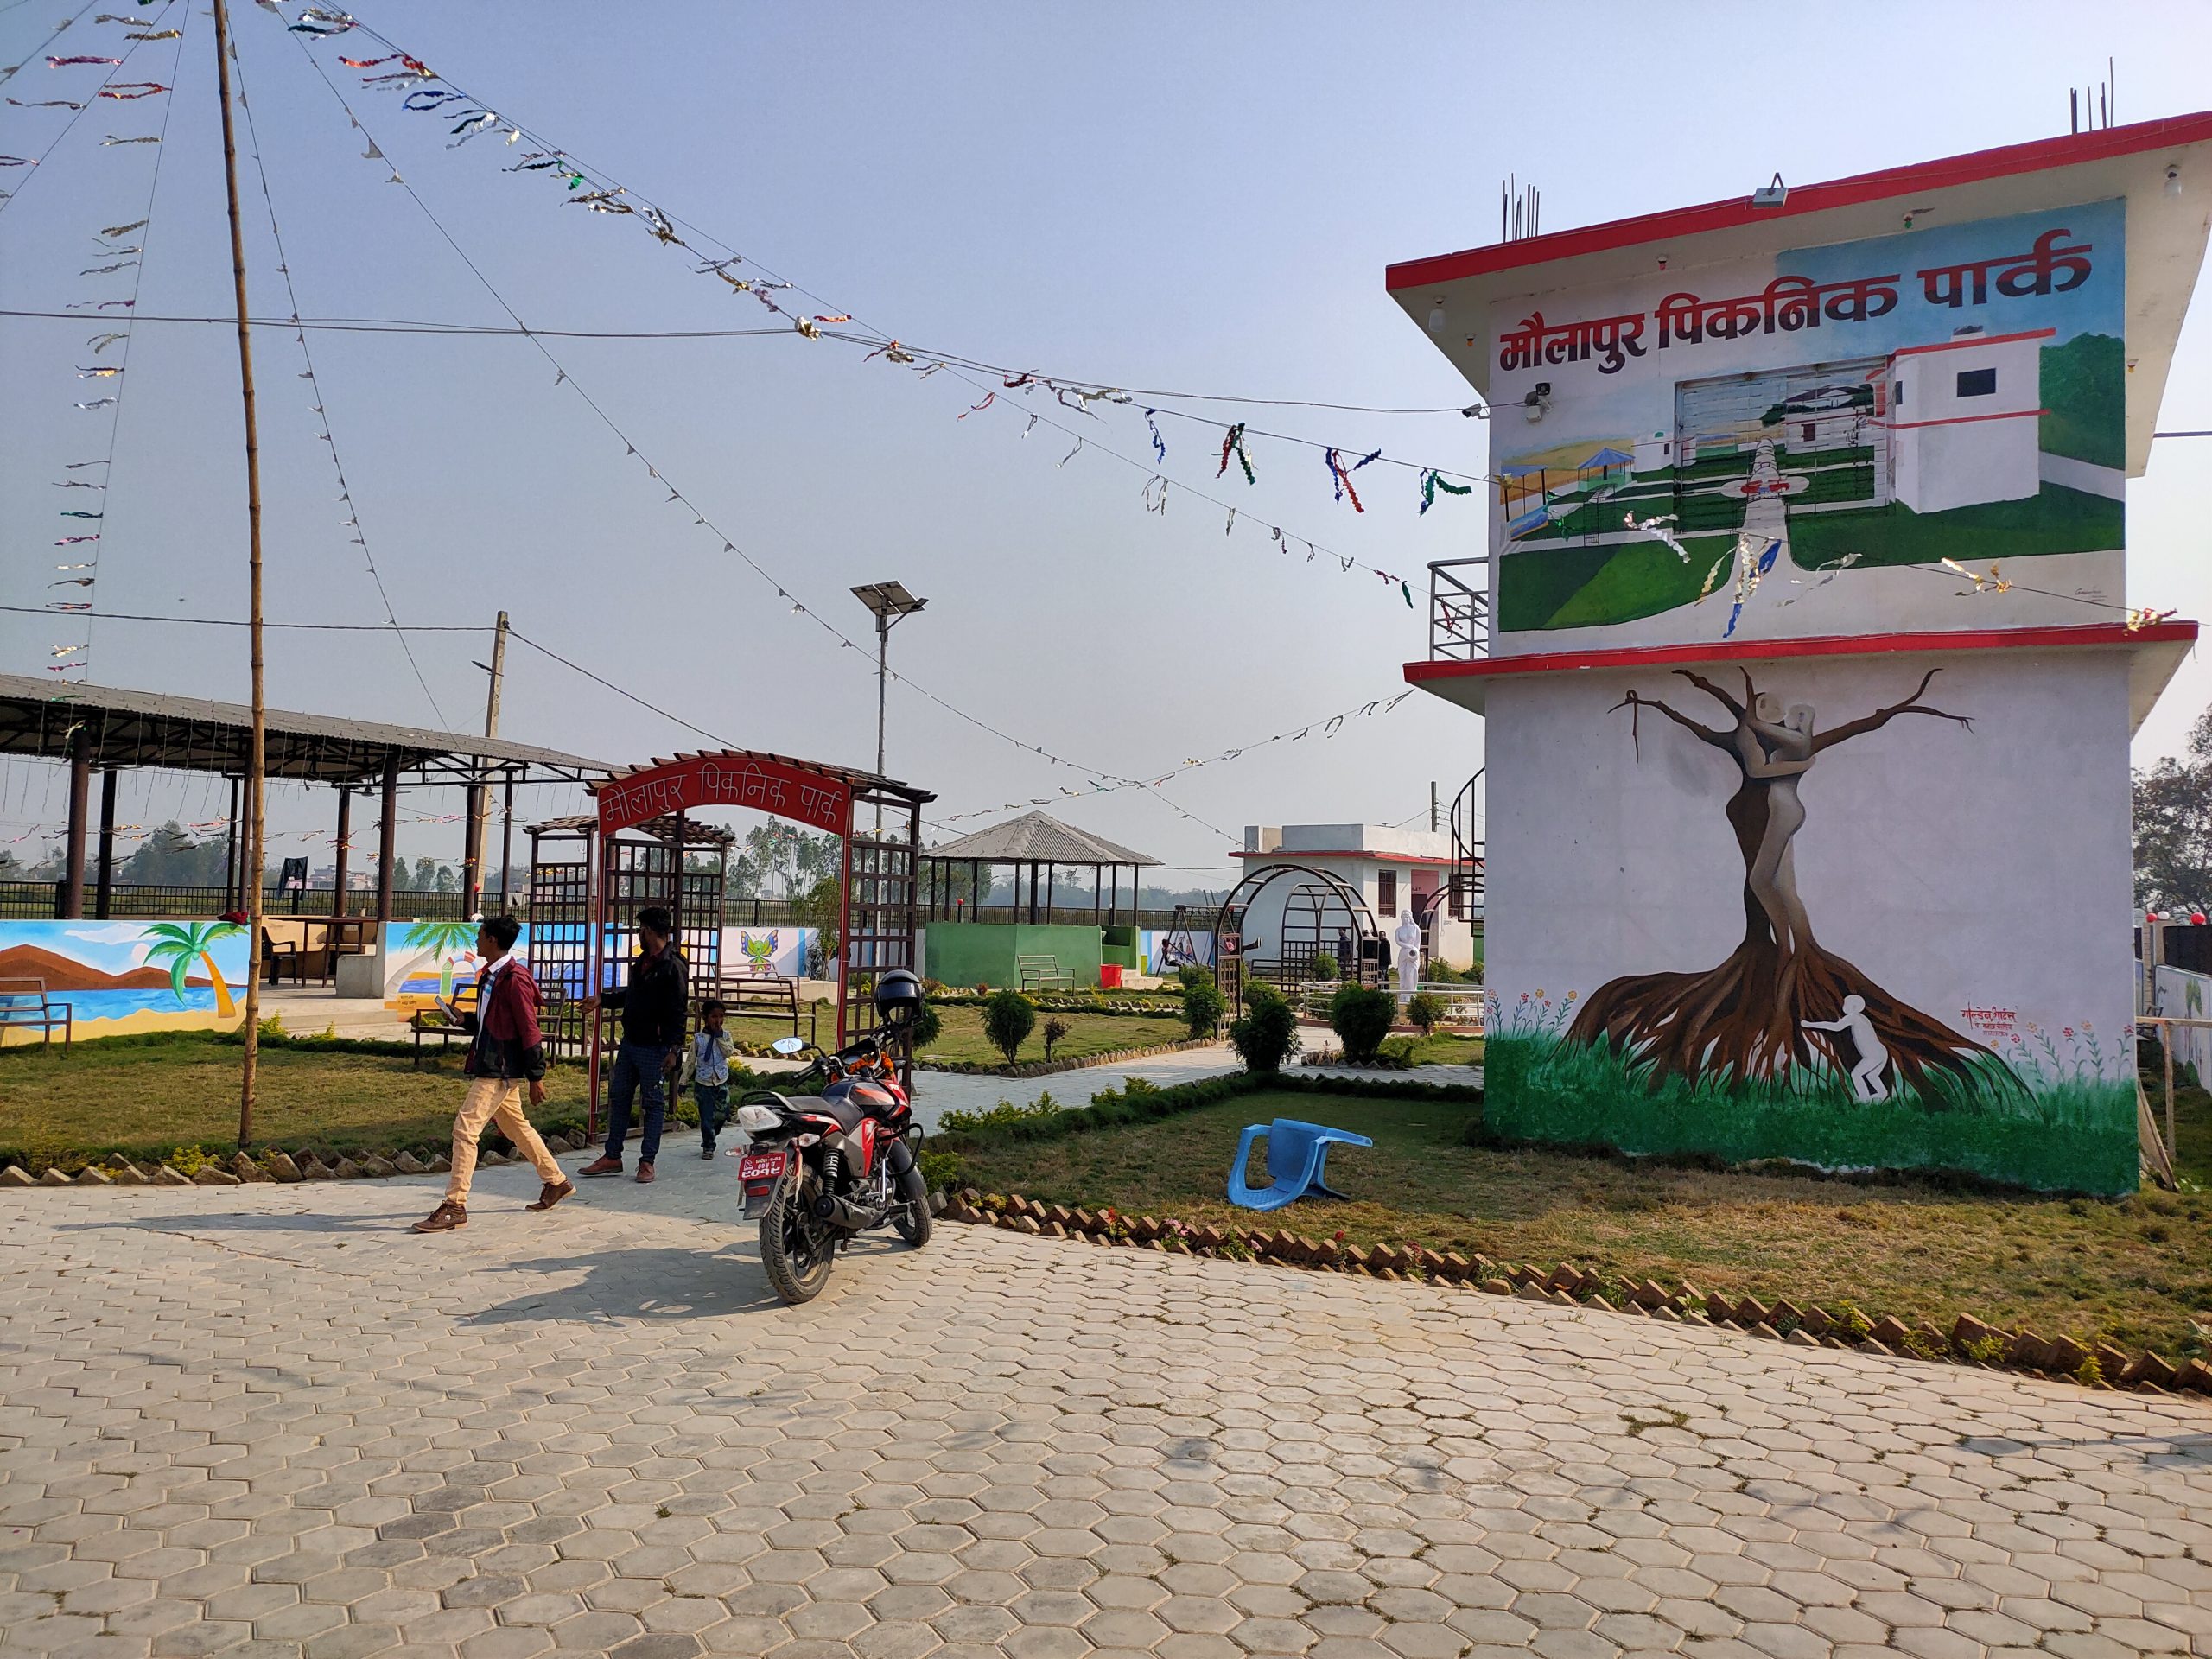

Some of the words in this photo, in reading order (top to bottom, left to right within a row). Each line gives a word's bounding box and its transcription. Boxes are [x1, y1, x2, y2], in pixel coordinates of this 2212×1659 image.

[1500, 311, 1648, 375] मौलापुर
[1655, 275, 1901, 350] पिकनिक
[1916, 228, 2093, 308] पार्क
[696, 762, 791, 807] पिकनिक
[800, 785, 843, 823] पार्क
